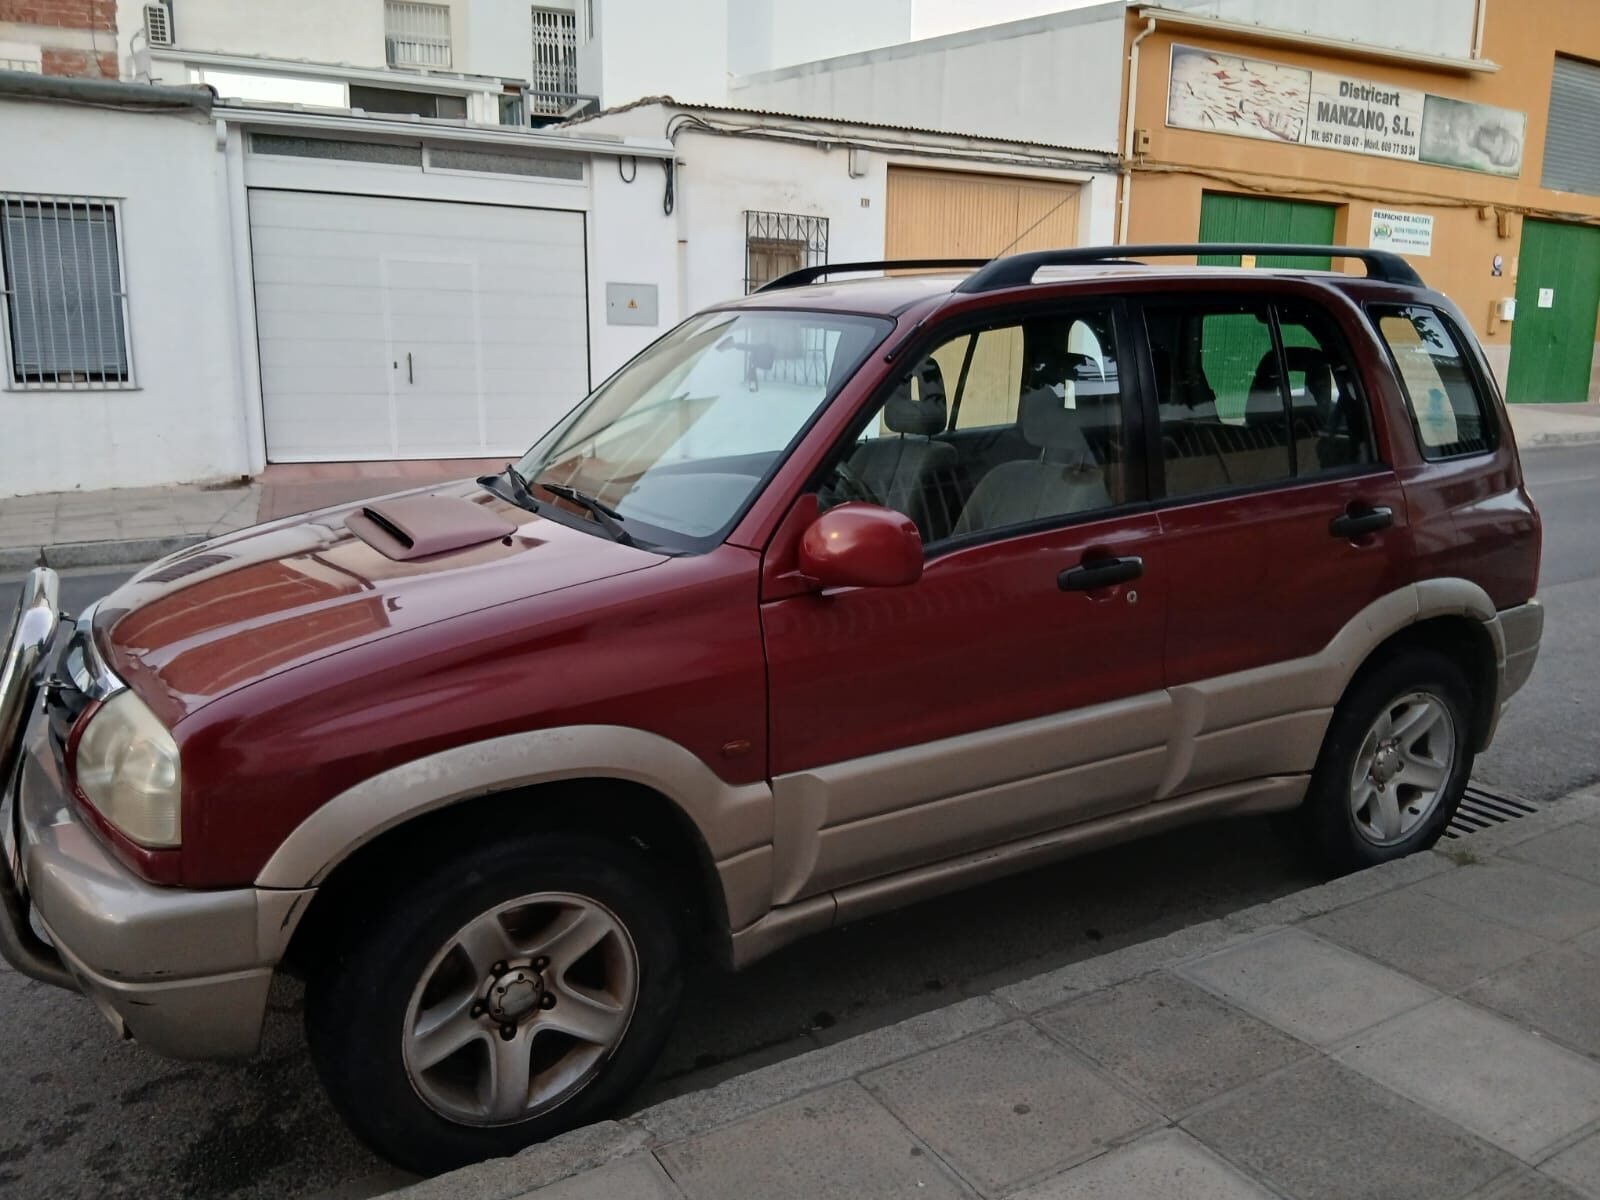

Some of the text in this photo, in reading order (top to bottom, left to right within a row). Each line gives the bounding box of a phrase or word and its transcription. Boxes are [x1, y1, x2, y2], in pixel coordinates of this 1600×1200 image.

[1339, 80, 1400, 107] Districart
[1317, 101, 1415, 137] MANZANO, S.L.
[1322, 132, 1333, 143] 957
